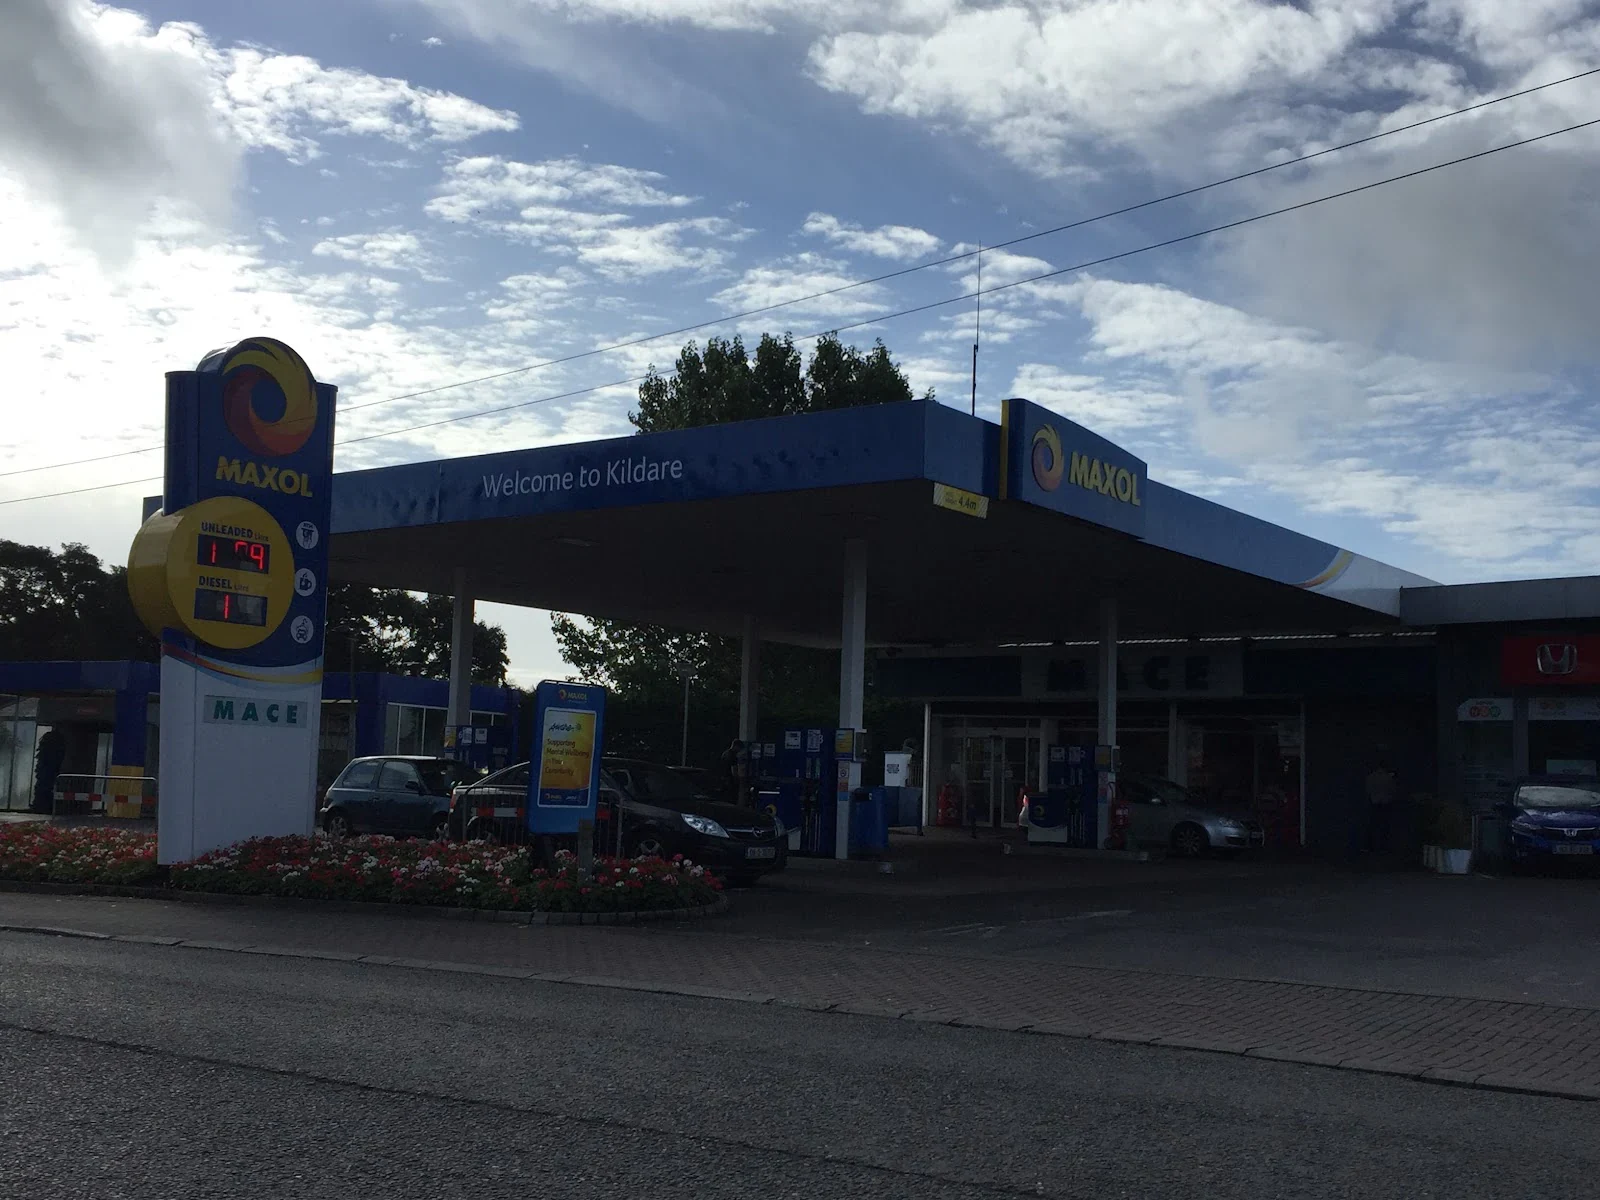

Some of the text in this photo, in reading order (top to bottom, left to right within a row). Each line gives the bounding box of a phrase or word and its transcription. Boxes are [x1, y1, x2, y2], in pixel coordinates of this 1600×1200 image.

[215, 456, 312, 498] MAXOL
[482, 456, 683, 498] Welcome to Kildare
[1069, 451, 1141, 507] MAXOL
[201, 521, 254, 539] UNLEADED
[199, 575, 233, 590] DIESEL
[213, 700, 298, 724] MACE
